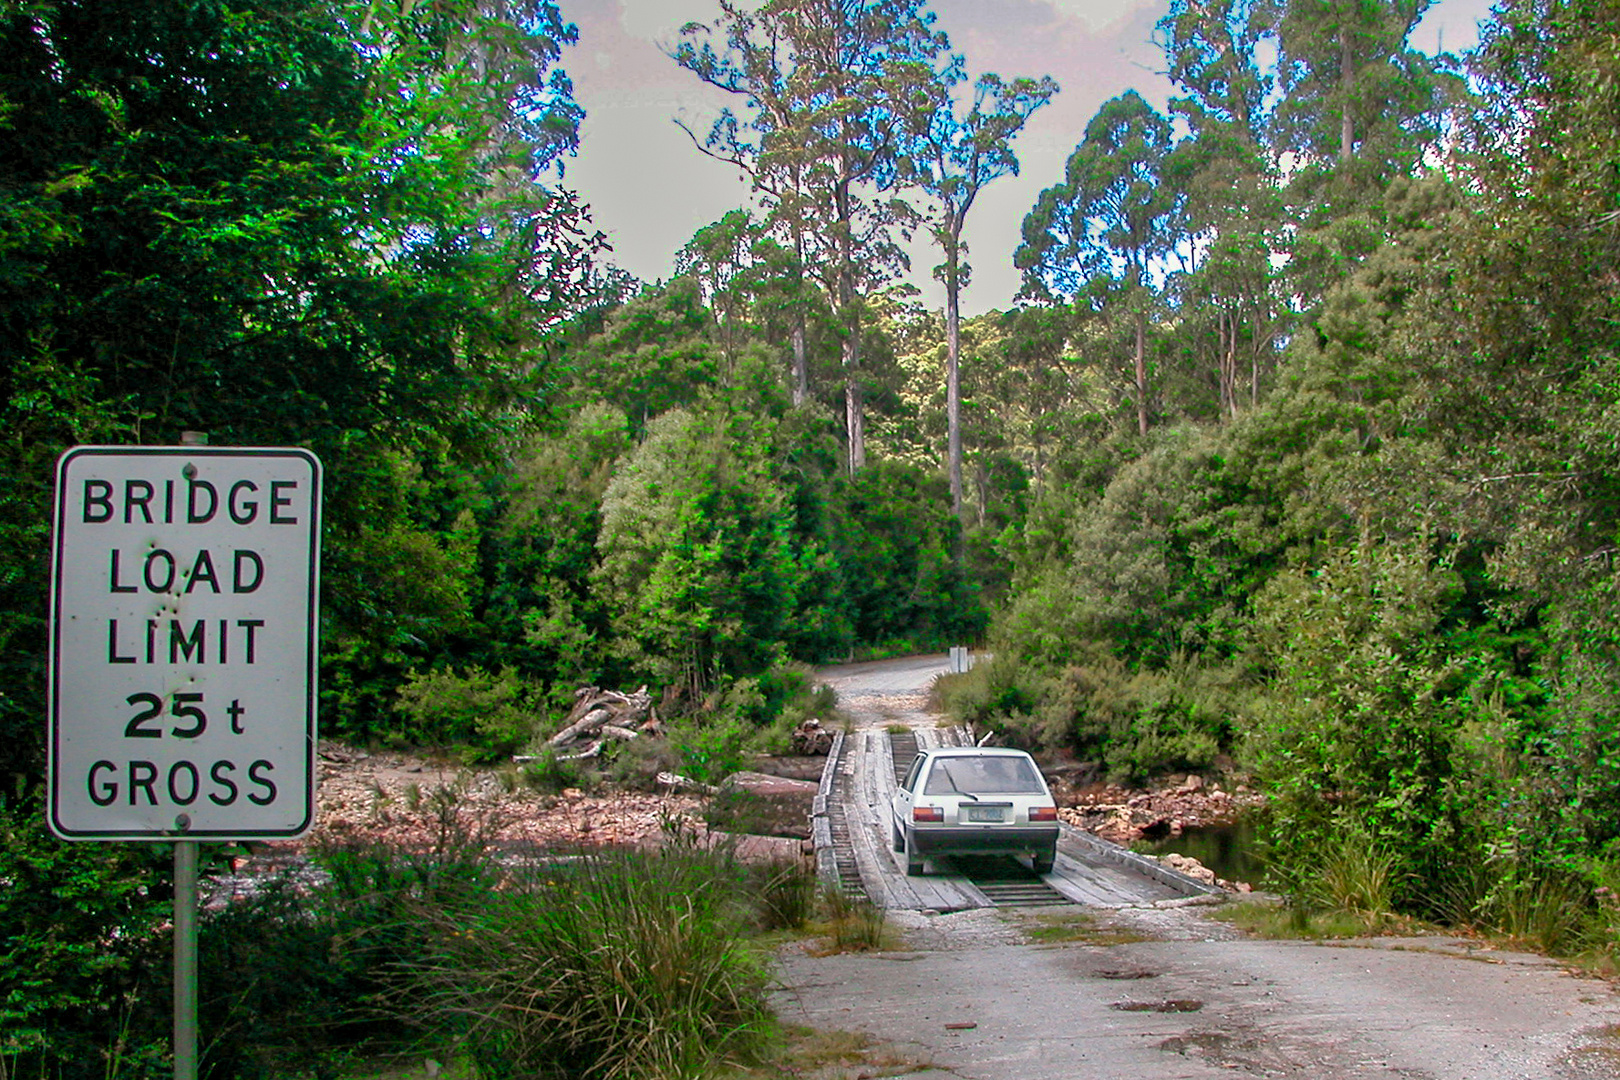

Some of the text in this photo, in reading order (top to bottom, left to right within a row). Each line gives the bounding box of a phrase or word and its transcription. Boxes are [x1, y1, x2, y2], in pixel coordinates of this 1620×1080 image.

[83, 479, 298, 525] BRIDGE
[110, 549, 265, 594] LOAD
[108, 619, 265, 664] LIMIT
[124, 692, 245, 739] 25 t
[88, 759, 278, 807] GROSS
